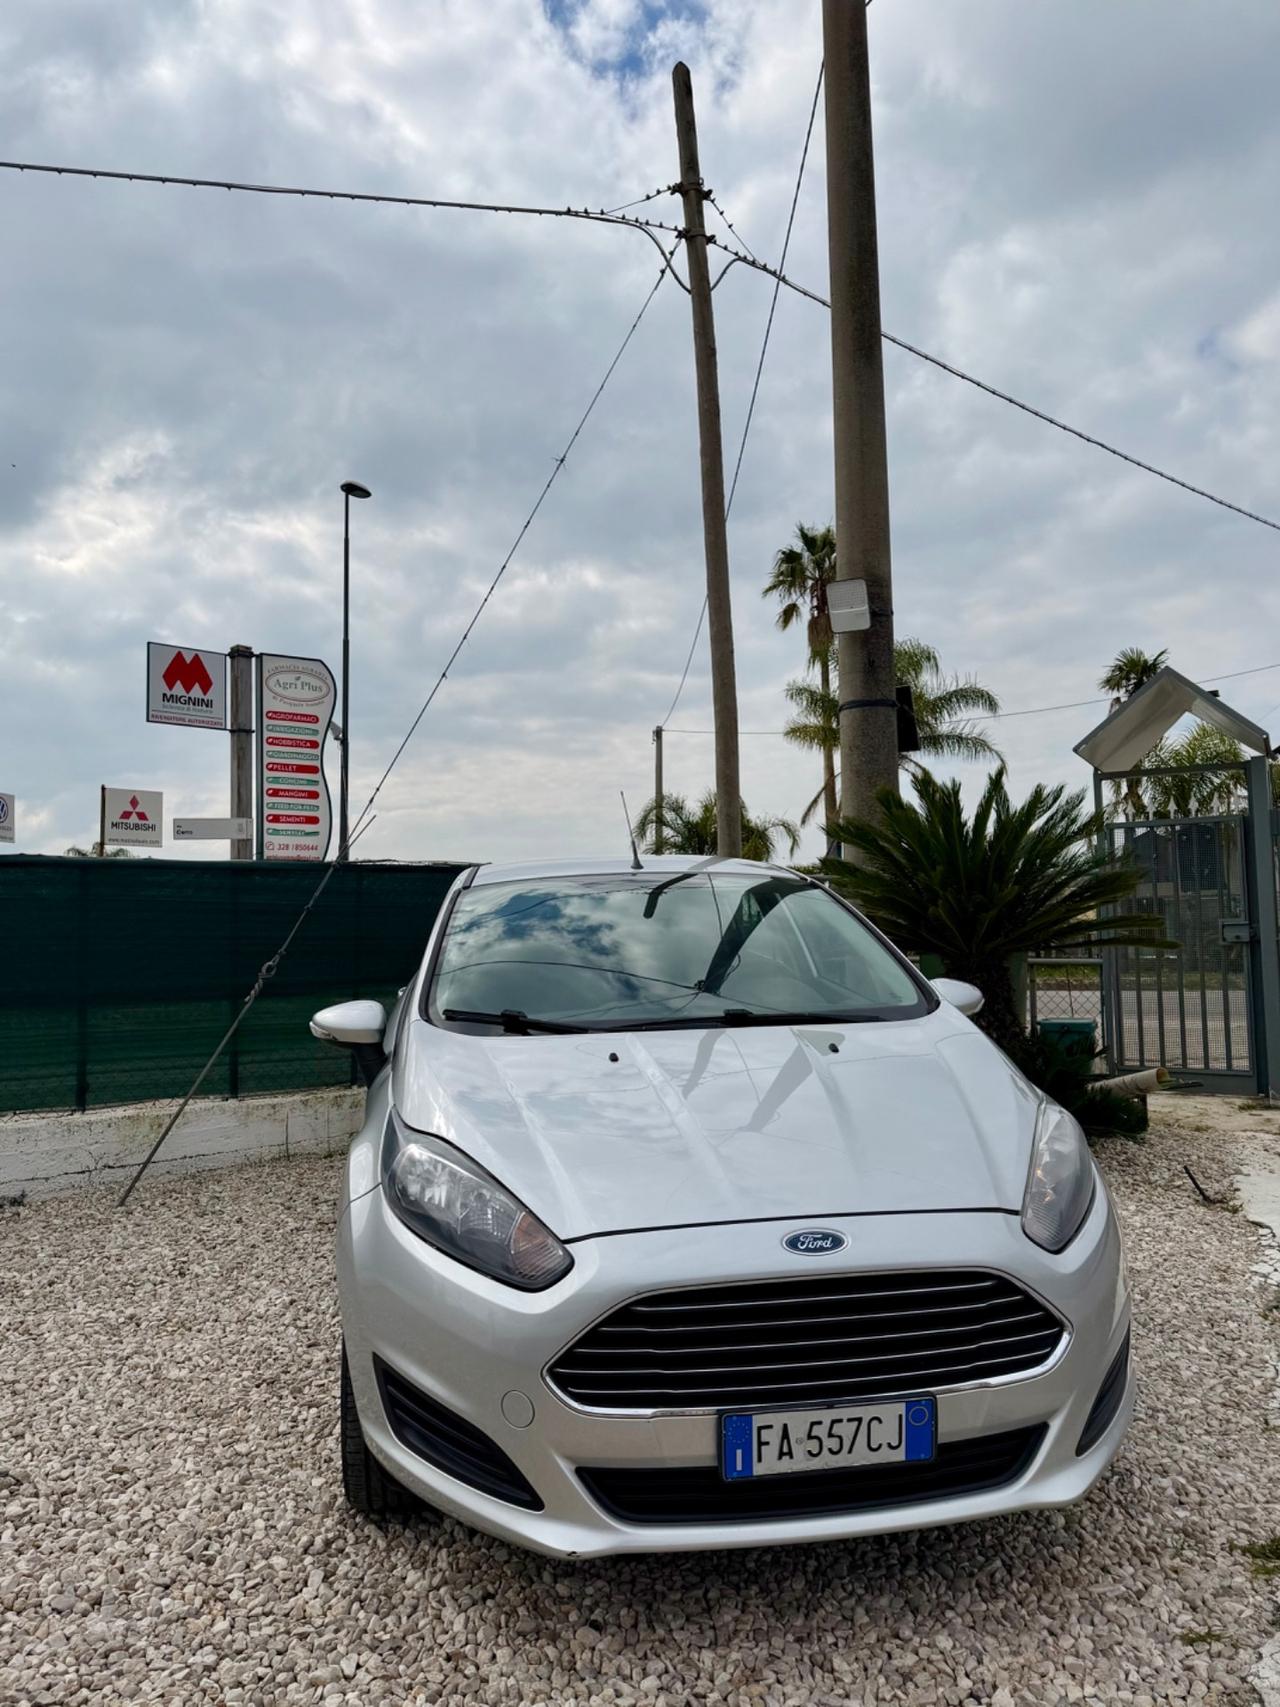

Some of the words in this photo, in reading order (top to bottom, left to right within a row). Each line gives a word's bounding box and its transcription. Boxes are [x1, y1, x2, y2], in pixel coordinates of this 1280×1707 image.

[274, 679, 297, 690] Agri
[300, 681, 323, 692] Plus
[162, 693, 213, 708] MIGNINI
[111, 821, 156, 832] MITSUBISHI
[277, 843, 289, 851] 328
[798, 1234, 833, 1249] Ford
[757, 1423, 794, 1463] FA
[807, 1414, 903, 1458] 557CJ
